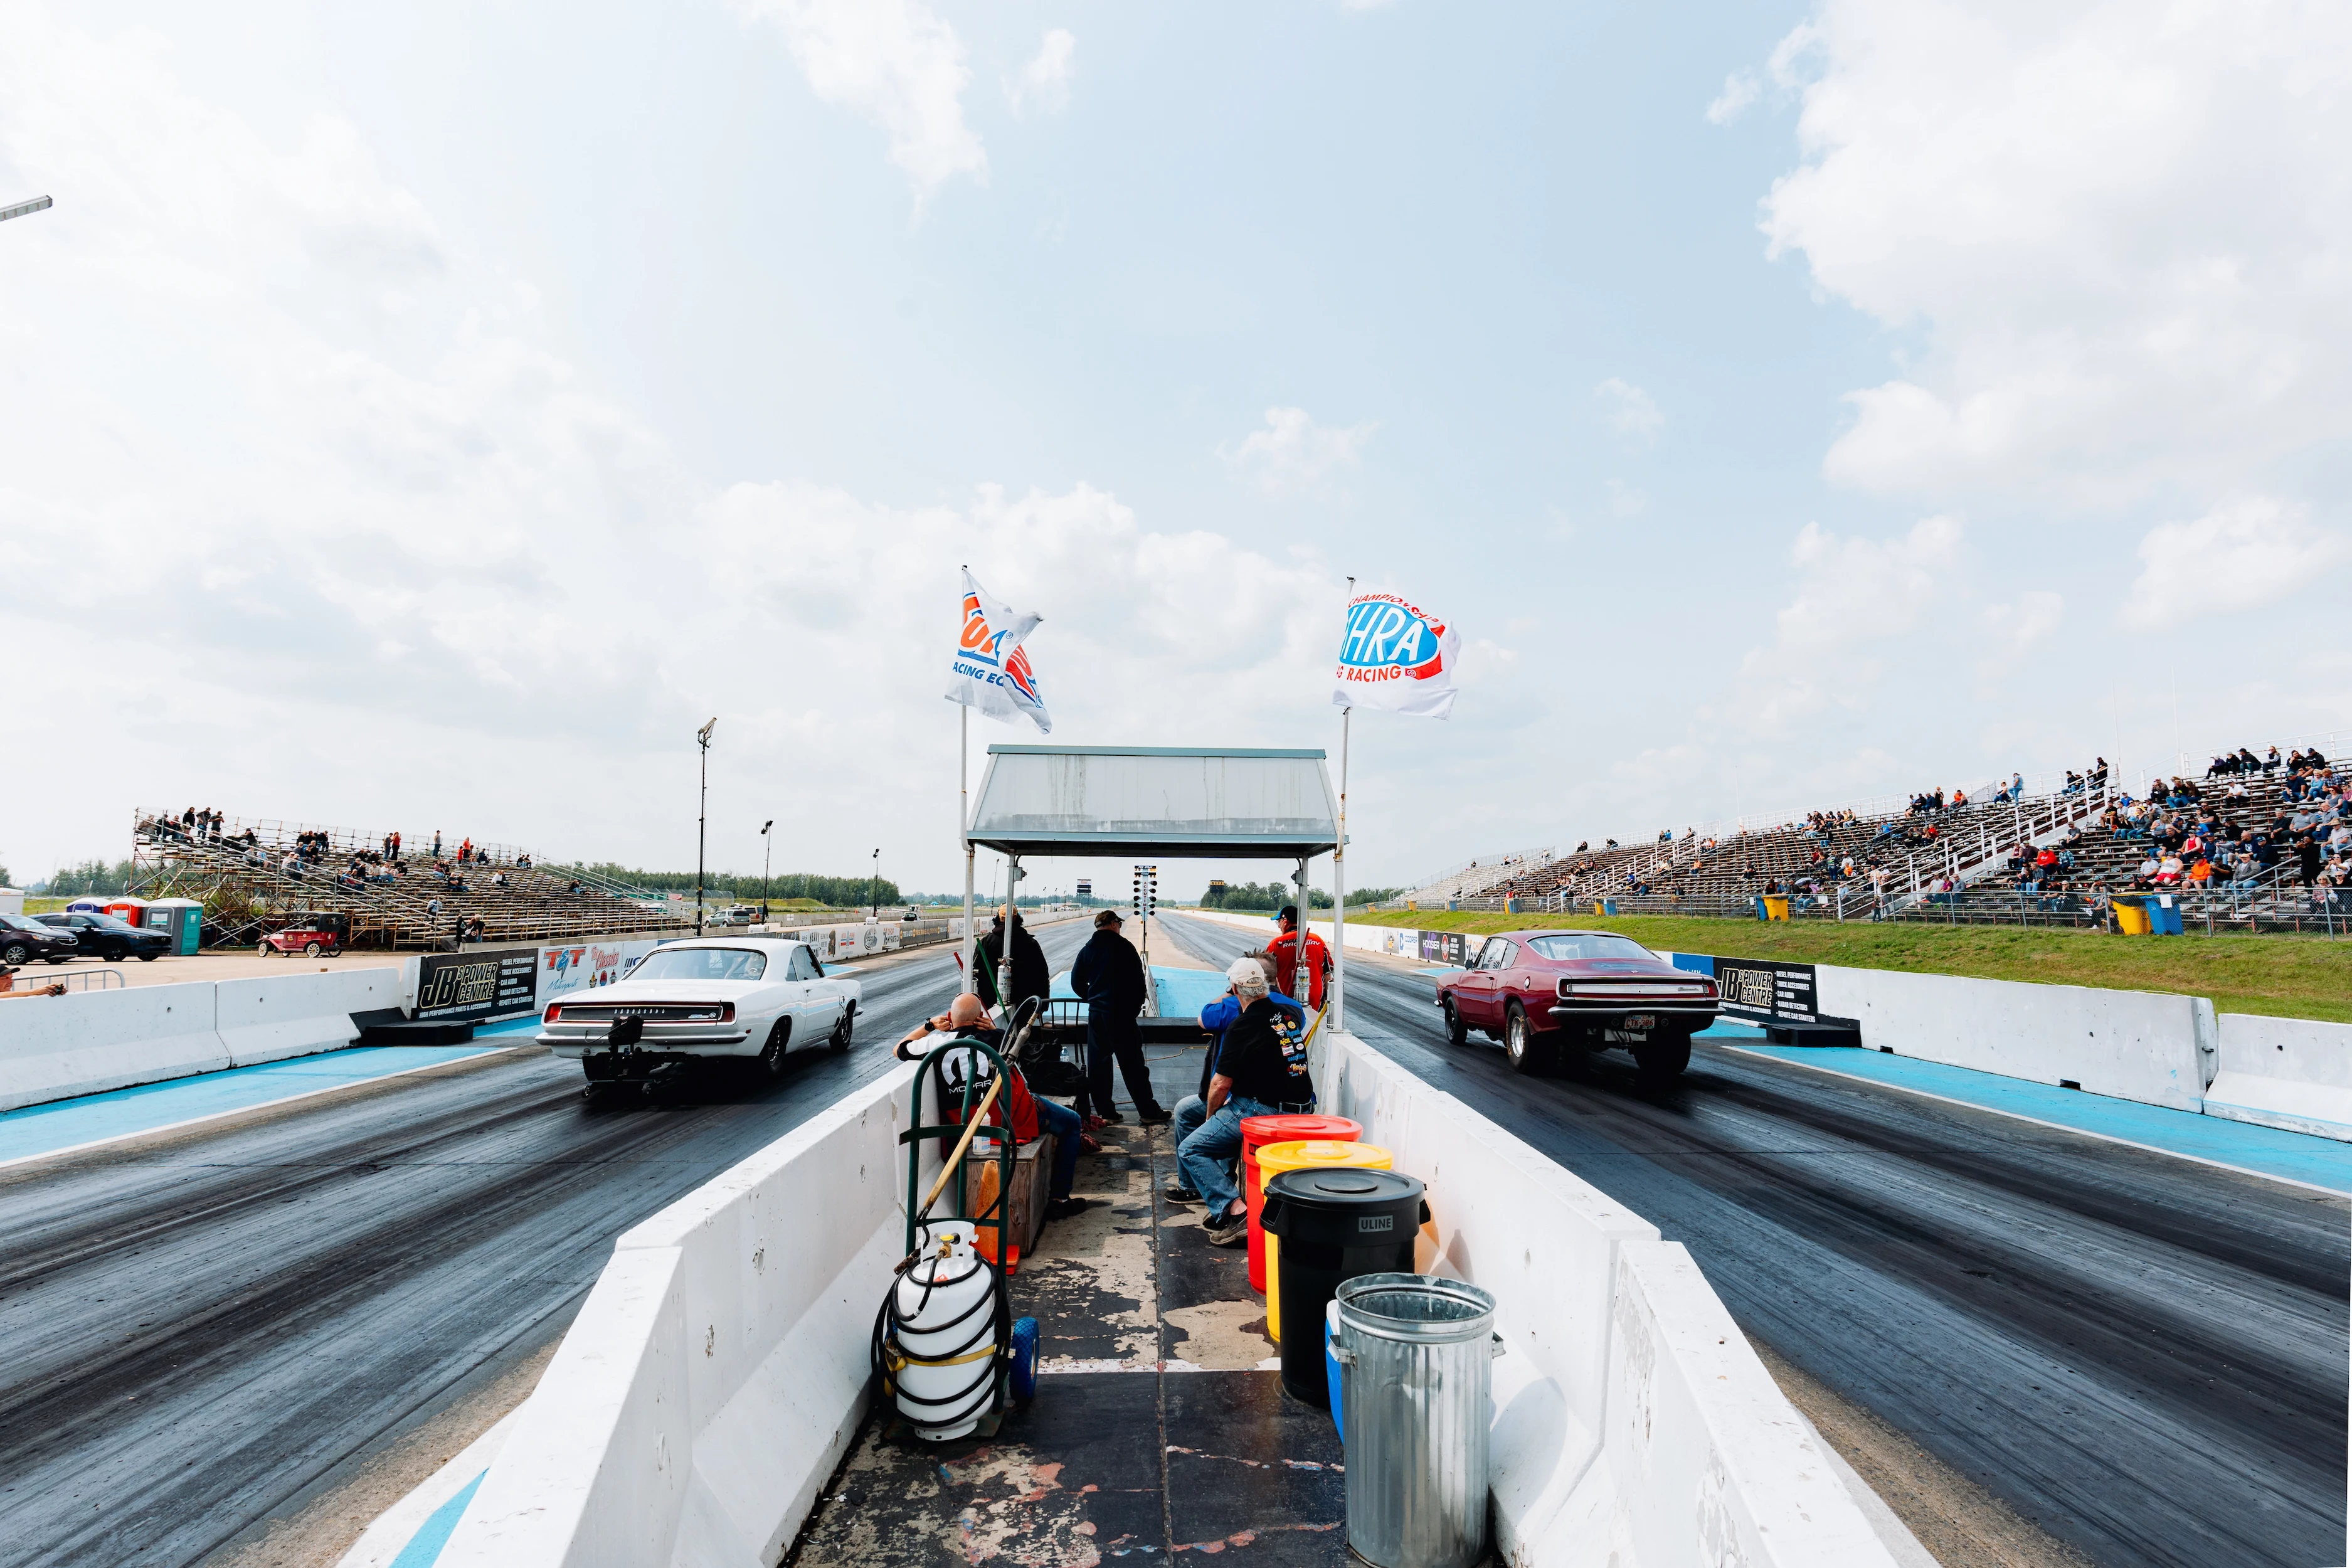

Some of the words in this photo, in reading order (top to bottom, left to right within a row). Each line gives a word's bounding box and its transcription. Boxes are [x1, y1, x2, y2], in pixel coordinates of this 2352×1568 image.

[1347, 665, 1401, 682] RACING
[1422, 940, 1440, 950] HOOSIER
[461, 962, 498, 983] POWER
[1787, 972, 1811, 980] PERFORMANCE
[1742, 970, 1773, 991] POWER
[1788, 982, 1809, 990] ACCESSORIES
[457, 980, 495, 1004] CENTRE
[1740, 986, 1772, 1007] CENTRE
[429, 1007, 455, 1017] PERFORMANCE
[455, 1005, 466, 1013] PARTS
[470, 1002, 492, 1010] ACCESSORIES
[1778, 1010, 1791, 1019] REMOTE
[1798, 1014, 1815, 1022] STARTERS
[948, 1079, 992, 1094] MOAR
[1361, 1218, 1391, 1230] ULINE
